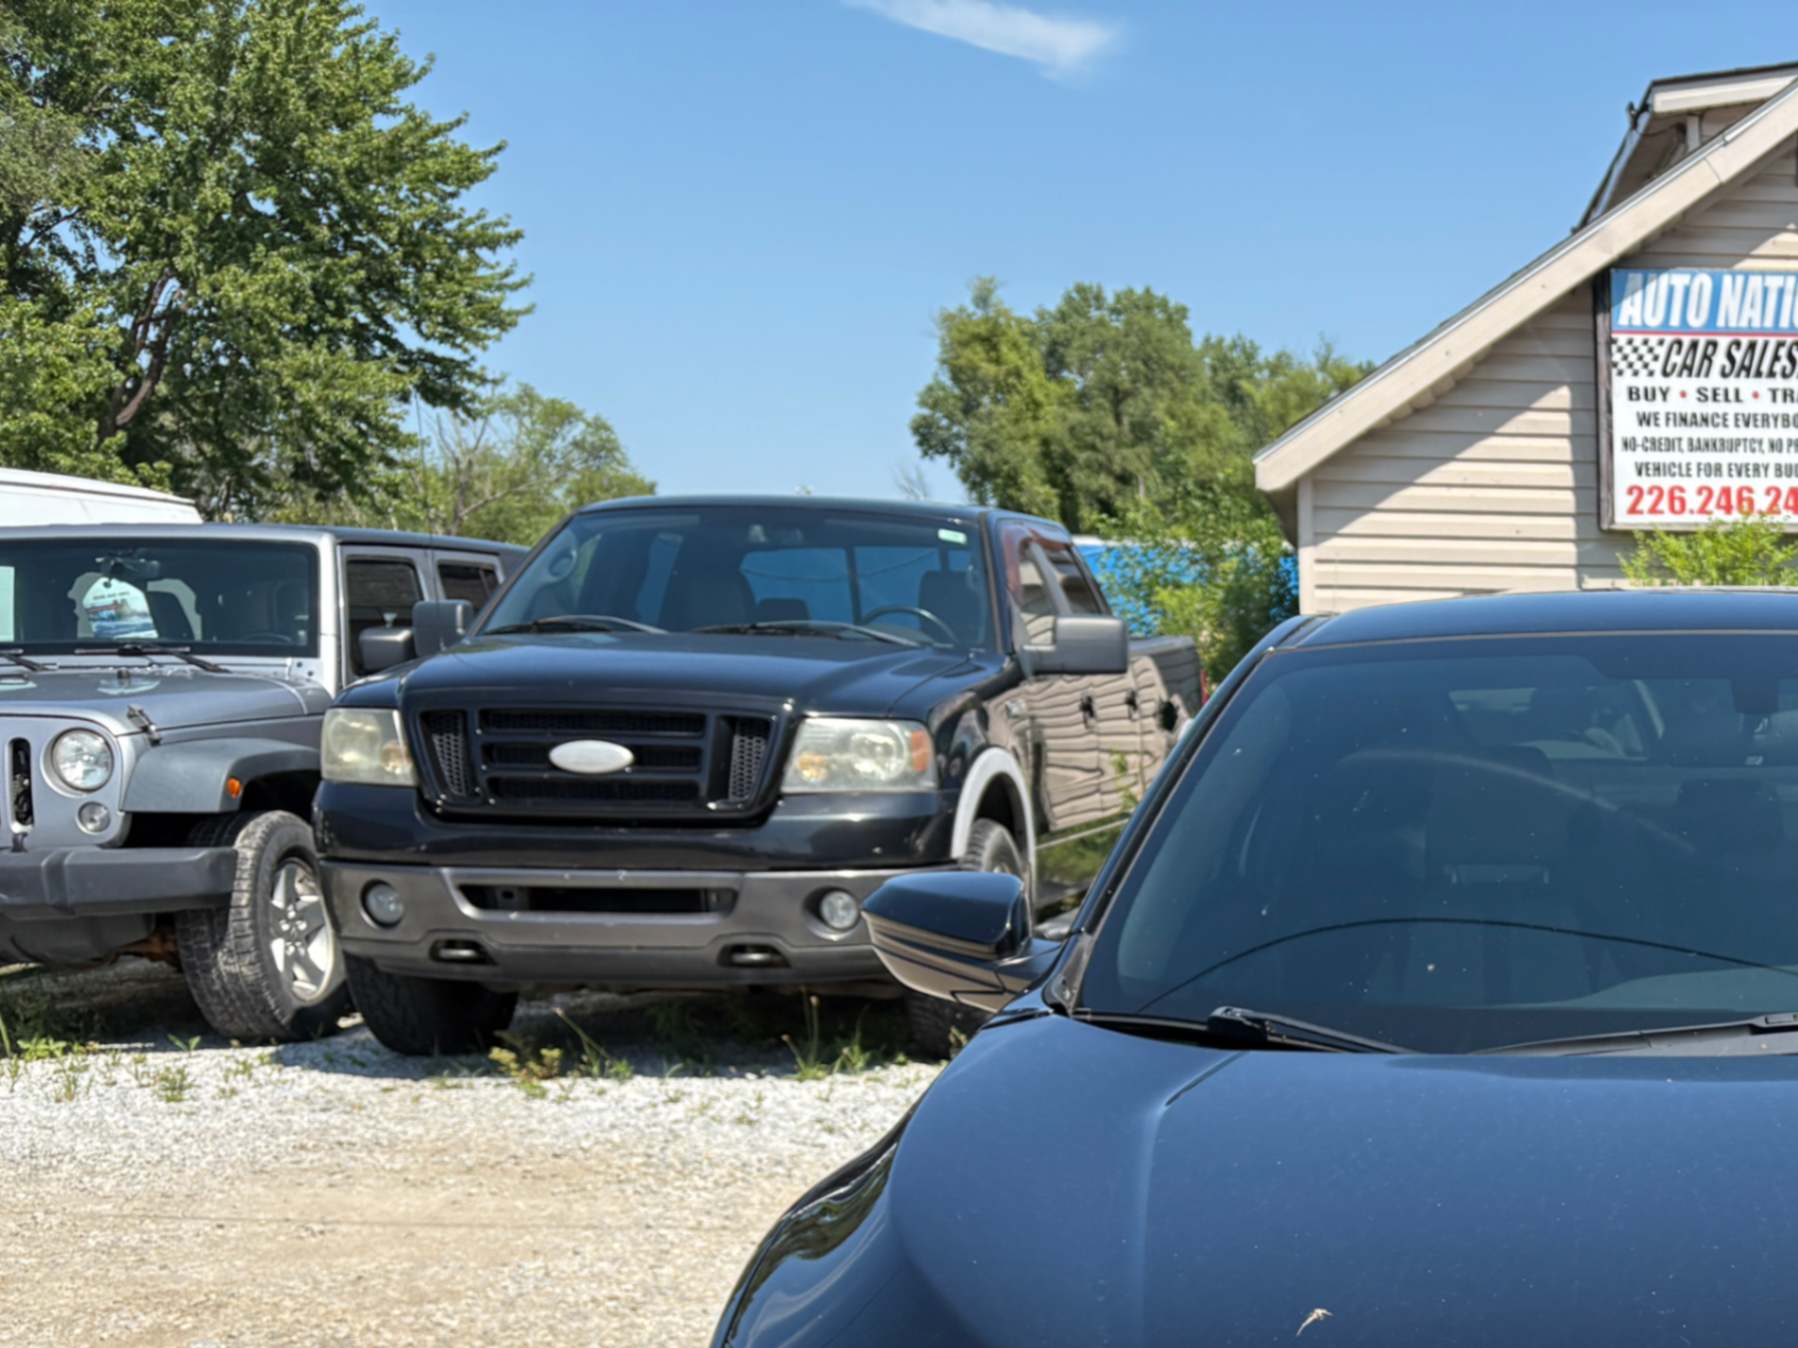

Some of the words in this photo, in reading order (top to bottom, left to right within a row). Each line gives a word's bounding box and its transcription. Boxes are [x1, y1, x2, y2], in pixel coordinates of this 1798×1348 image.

[1618, 272, 1713, 328] AUTO
[1661, 337, 1719, 379] CAR
[1627, 386, 1671, 402] BUY
[1695, 386, 1744, 403] SELL
[1636, 411, 1661, 428] WE
[1664, 412, 1729, 429] FINANCE
[1621, 436, 1685, 453] NO-CREDIT,
[1687, 437, 1765, 454] BANKRUPTCY,
[1768, 438, 1783, 454] NO
[1635, 461, 1693, 478] VEHICLE
[1696, 462, 1723, 478] FOR
[1727, 462, 1770, 478] EVERY
